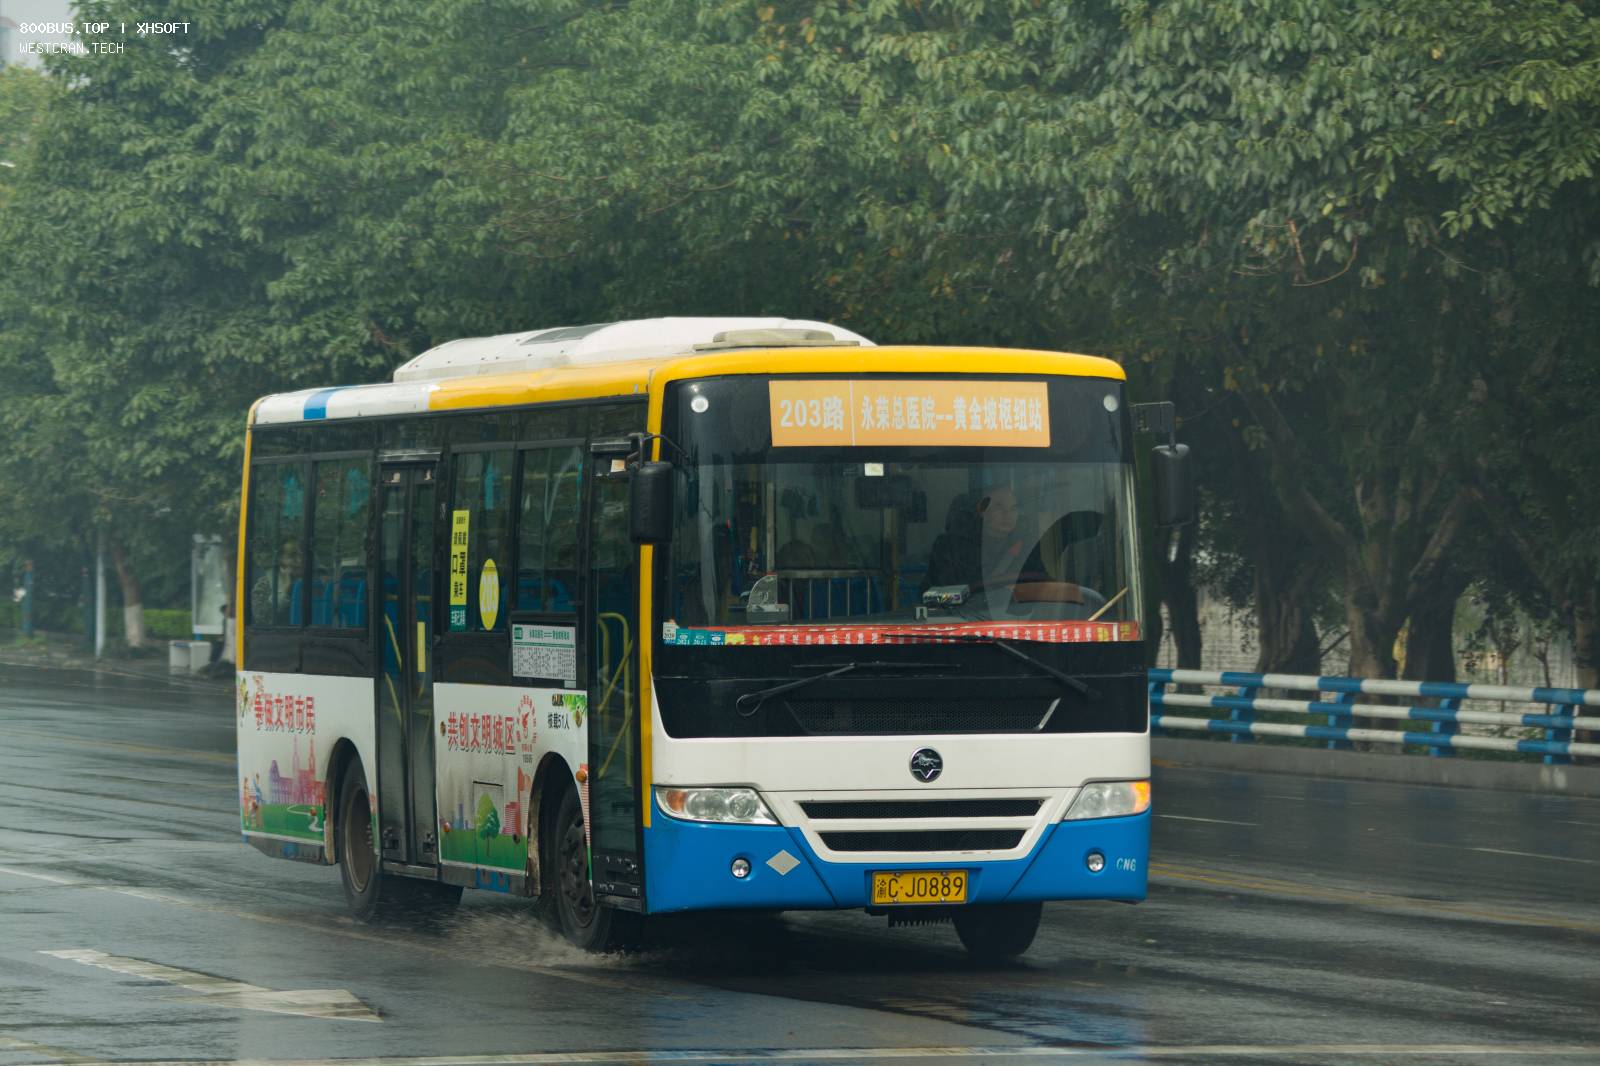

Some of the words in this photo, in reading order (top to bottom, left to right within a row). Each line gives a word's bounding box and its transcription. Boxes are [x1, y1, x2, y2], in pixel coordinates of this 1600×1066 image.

[780, 397, 845, 431] 203路
[447, 711, 516, 754] 共创文明城区
[1115, 858, 1137, 872] CNG
